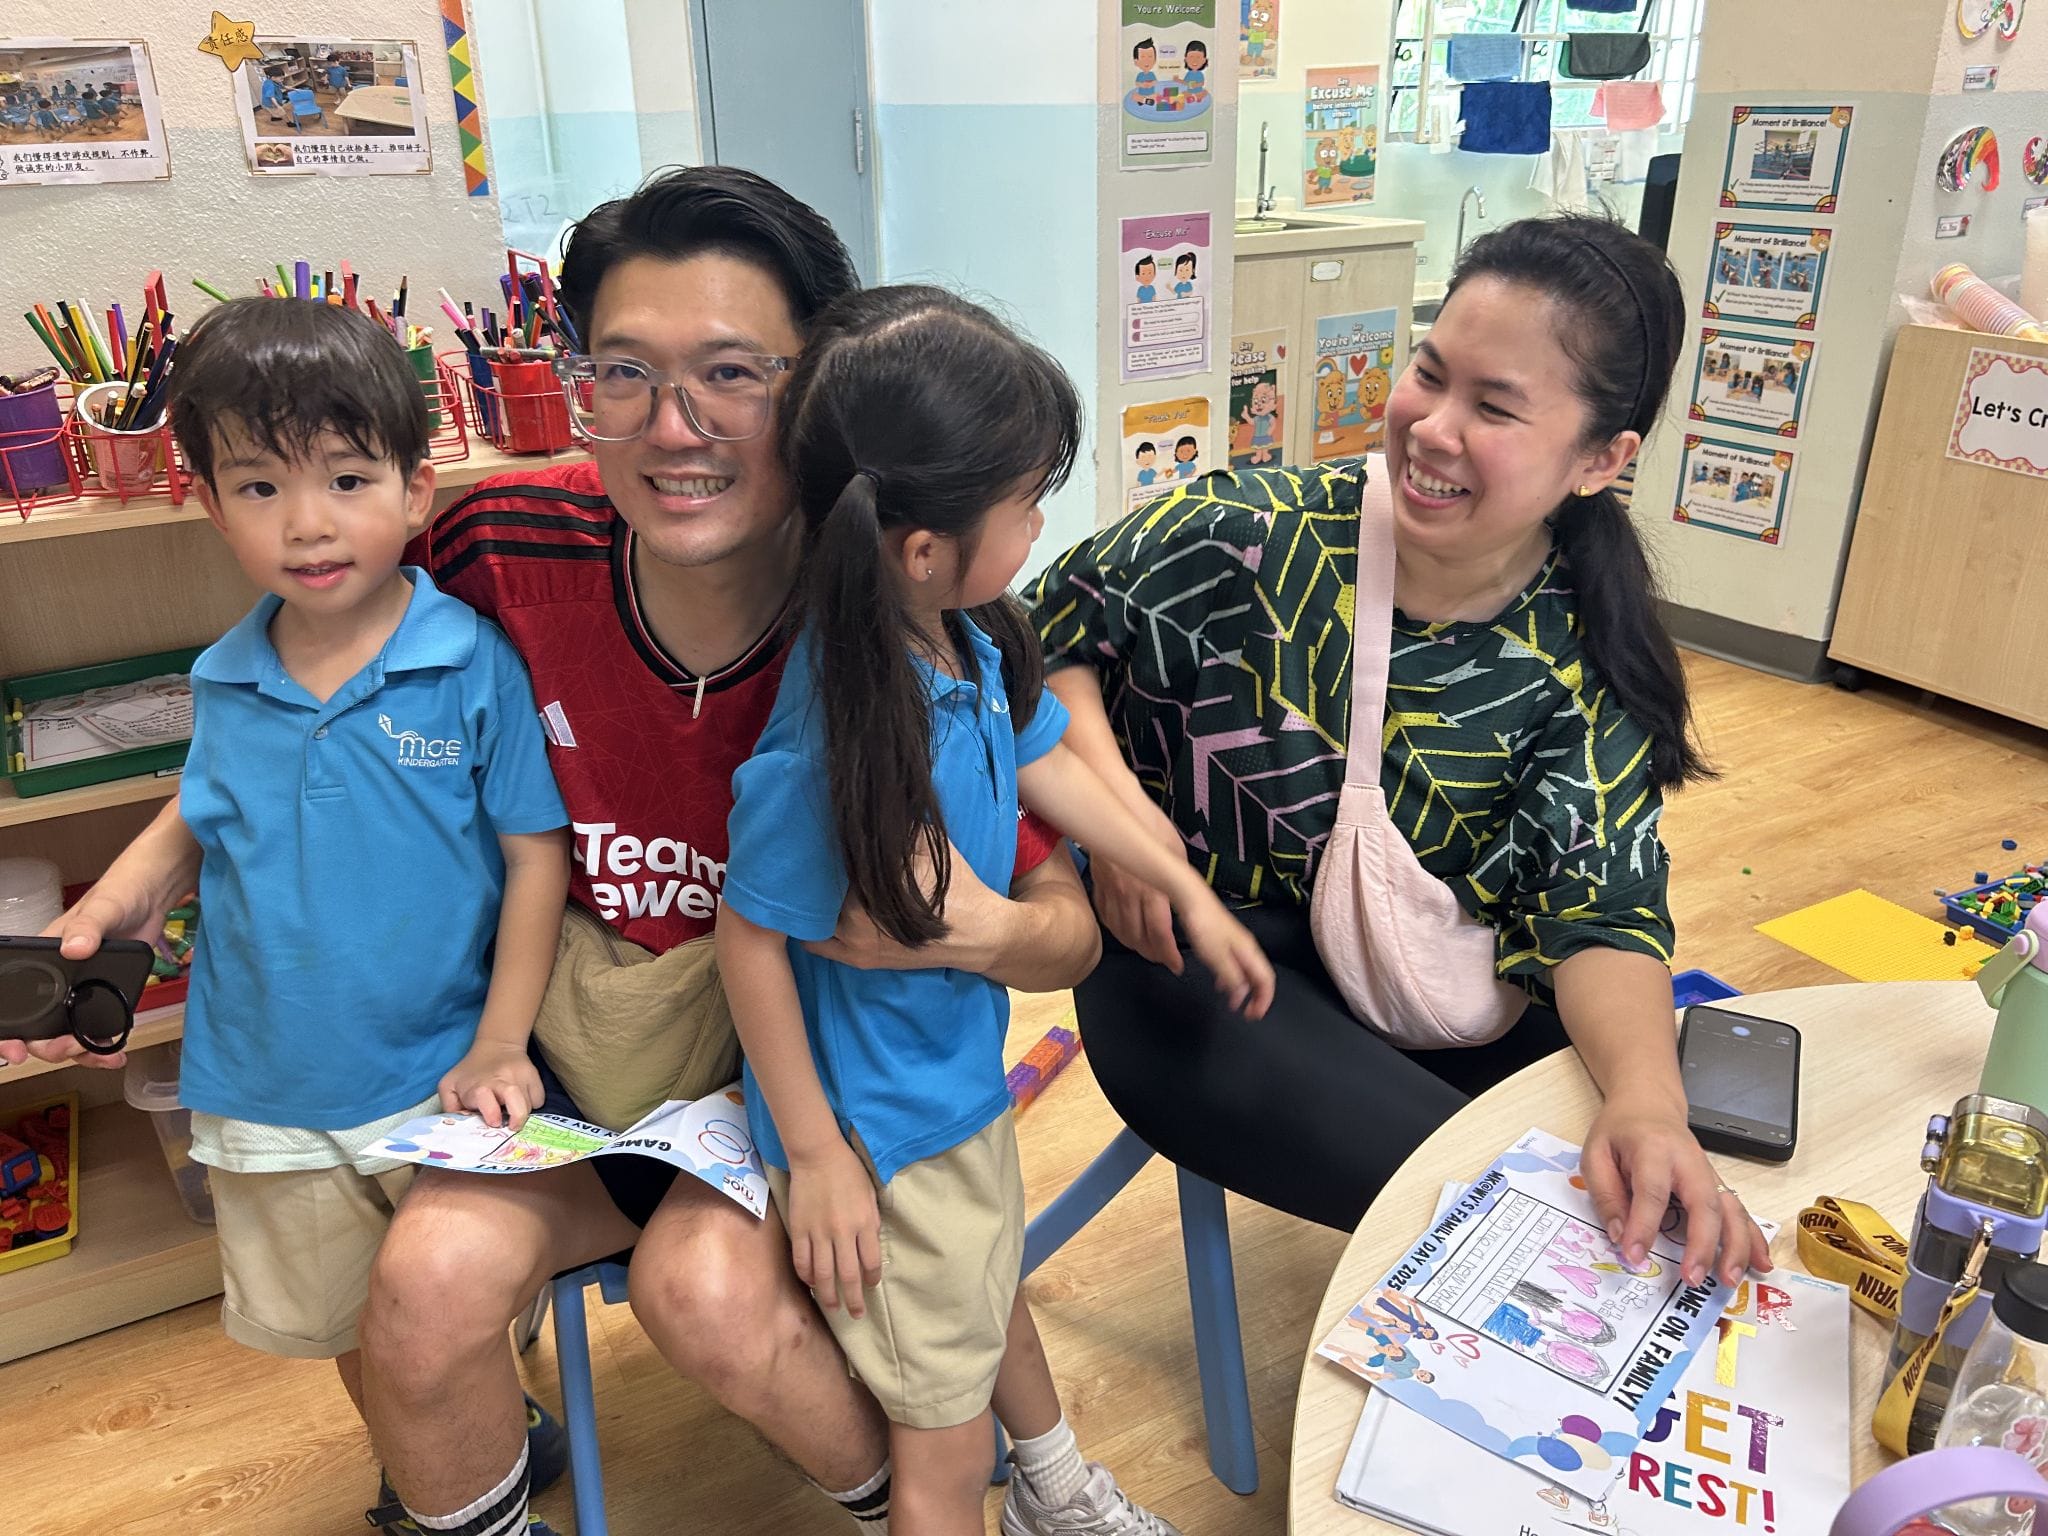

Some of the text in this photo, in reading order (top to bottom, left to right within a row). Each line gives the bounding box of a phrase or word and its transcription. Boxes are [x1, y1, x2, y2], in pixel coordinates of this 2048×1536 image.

[1311, 84, 1375, 100] Excuse Me
[1752, 118, 1827, 128] Moment of Brilliance!
[1734, 235, 1807, 248] Moment of Brilliance!
[1352, 330, 1393, 344] Welcome
[1720, 342, 1789, 358] Moment of Brilliance!
[1972, 396, 2022, 423] Let's
[1702, 448, 1728, 459] Moment
[1739, 455, 1770, 467] Brilliance!
[397, 756, 459, 768] KINDERGARTEN
[570, 1121, 599, 1133] DAY
[611, 1137, 672, 1152] GAME
[1385, 1169, 1504, 1292] MK@WV'S FAMILY DAY 2025
[1653, 1313, 1690, 1343] ON,
[1613, 1340, 1670, 1412] FAMILY!
[1628, 1451, 1776, 1534] REST!
